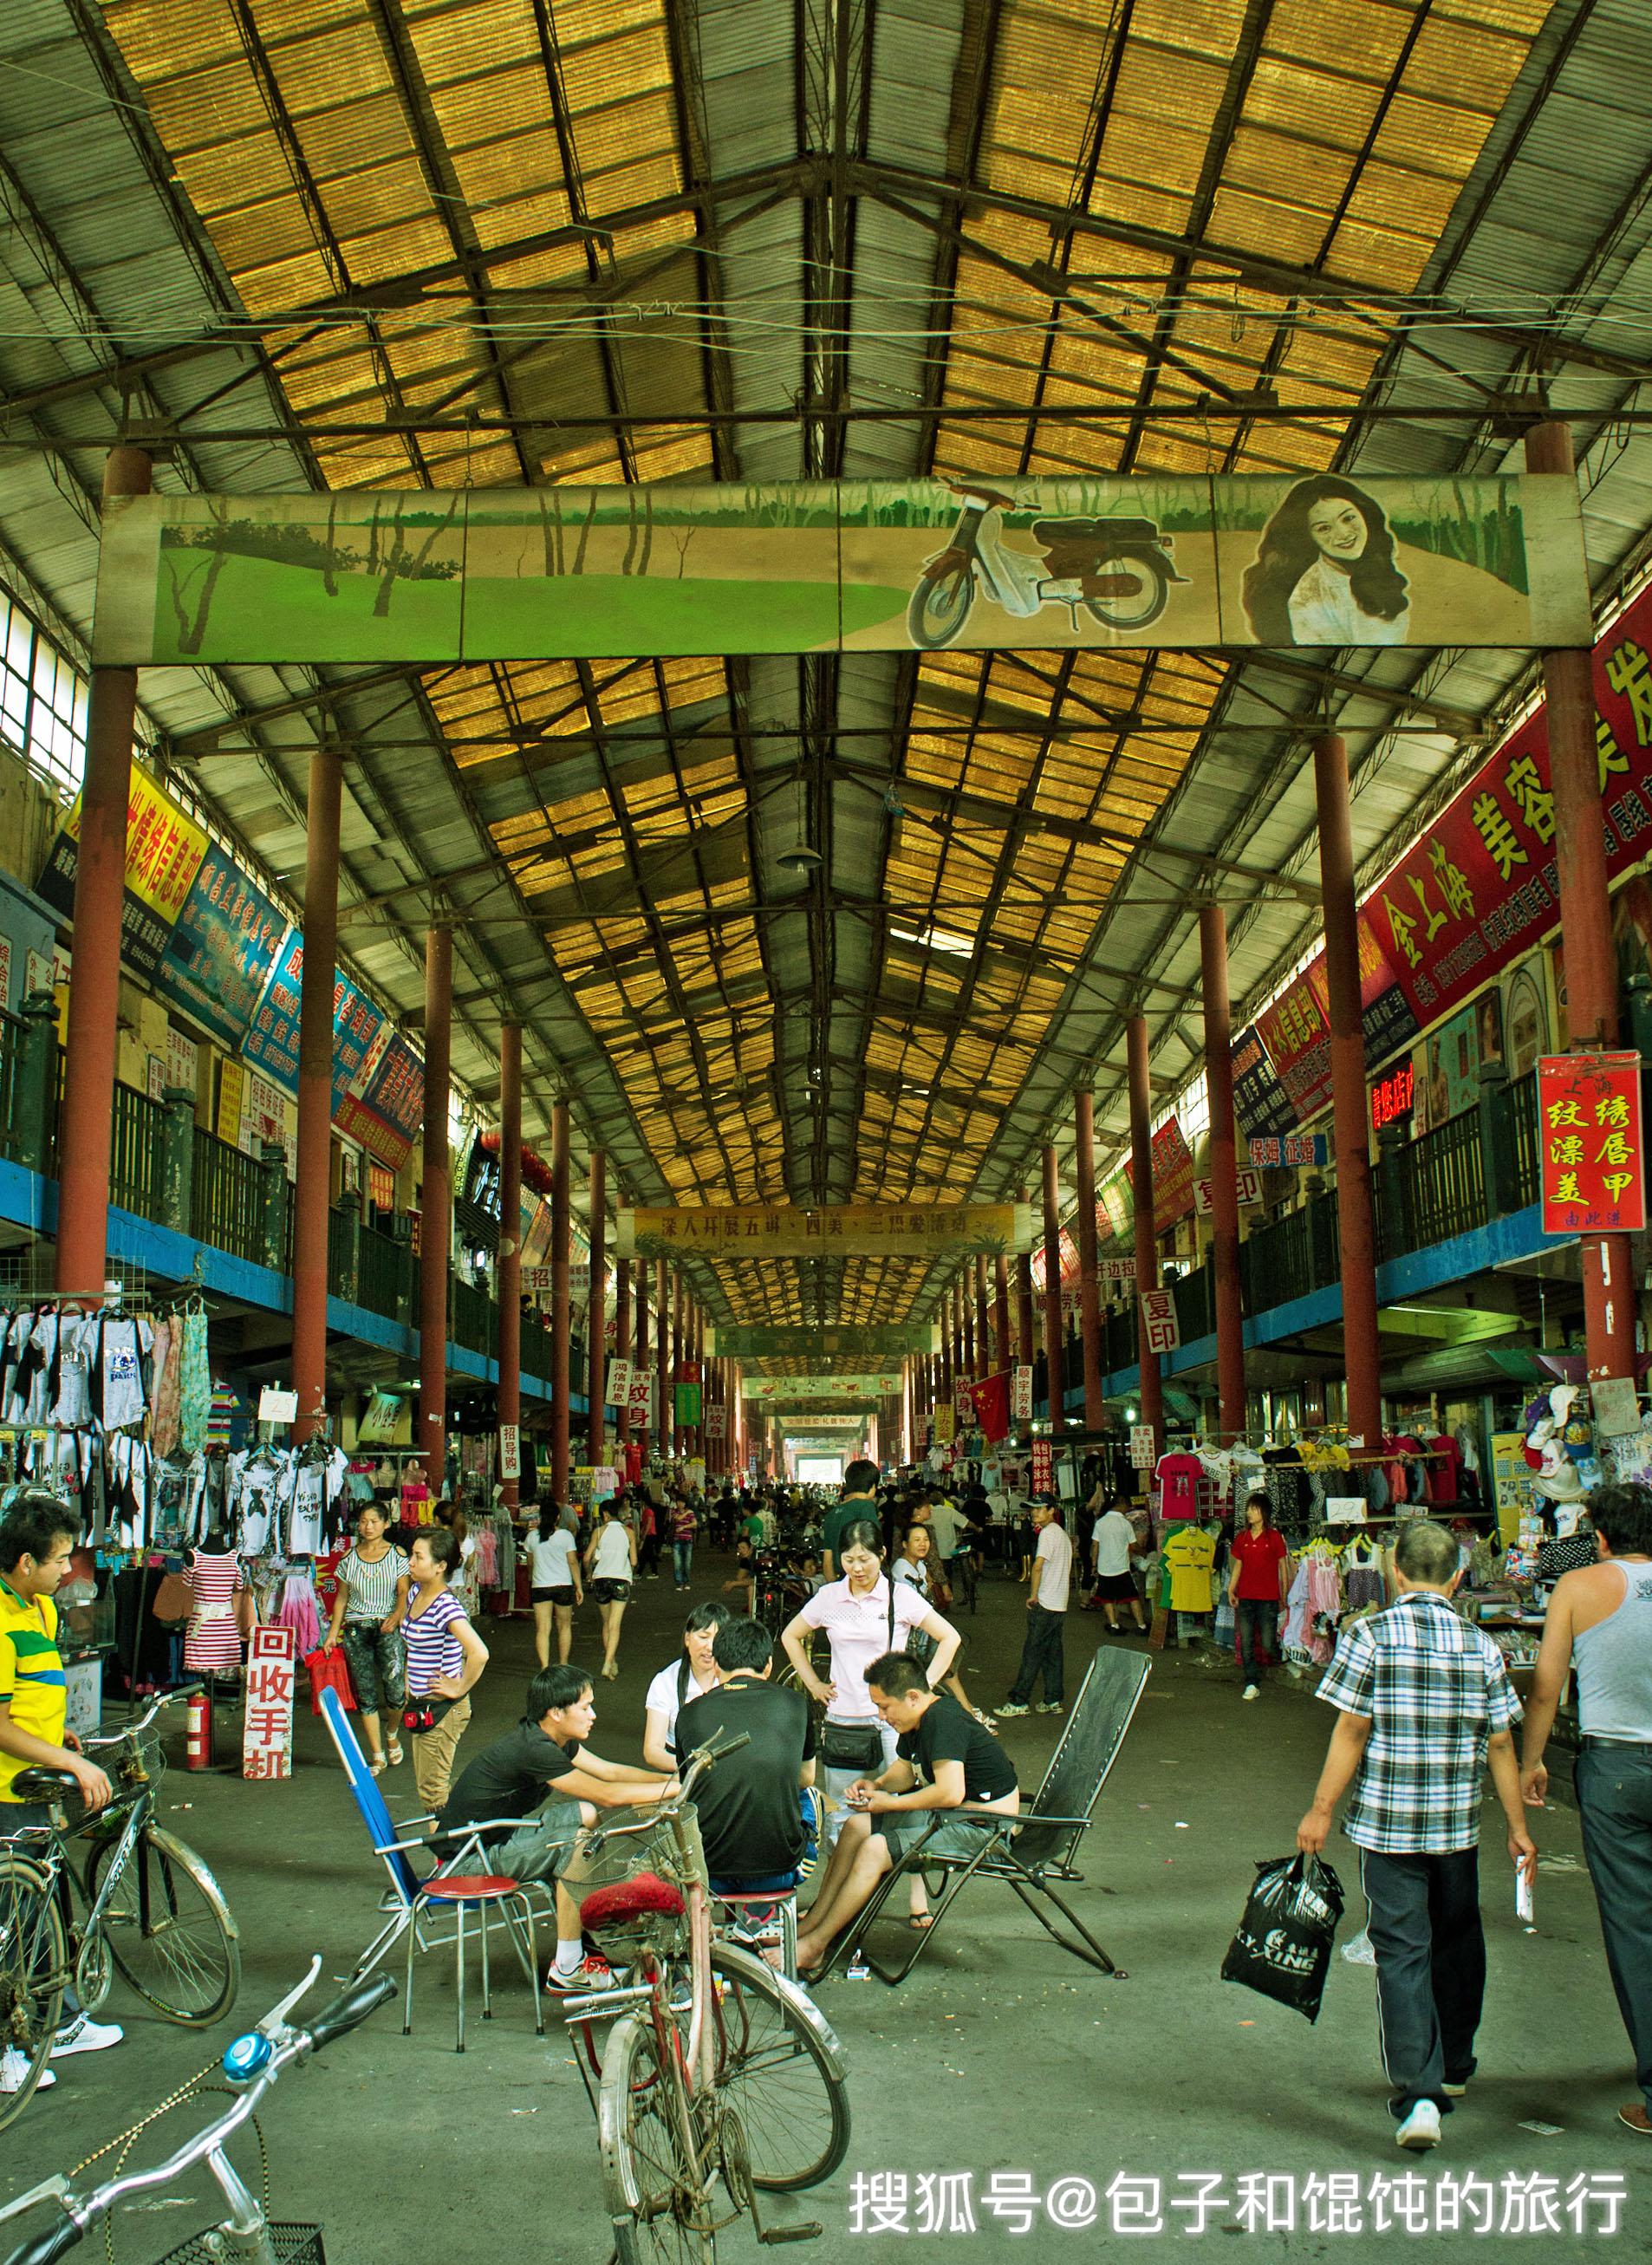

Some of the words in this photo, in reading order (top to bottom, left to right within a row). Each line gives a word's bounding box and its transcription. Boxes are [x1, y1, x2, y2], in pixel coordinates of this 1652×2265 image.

[1473, 752, 1557, 881] 美容
[1546, 1095, 1630, 1129] 纹绣
[1249, 1137, 1280, 1168] 保姆
[1285, 1136, 1316, 1167] 征婚
[1549, 1131, 1636, 1166] 漂唇
[1549, 1171, 1634, 1206] 美甲
[1144, 1292, 1176, 1351] 复印
[270, 1397, 292, 1416] 25
[628, 1383, 650, 1427] 纹身
[956, 1378, 972, 1413] 纹身
[1018, 1367, 1031, 1417] 顺宇劳务
[503, 1427, 517, 1471] 招导购
[322, 1578, 336, 1593] 元
[244, 1626, 294, 1779] 回收手机
